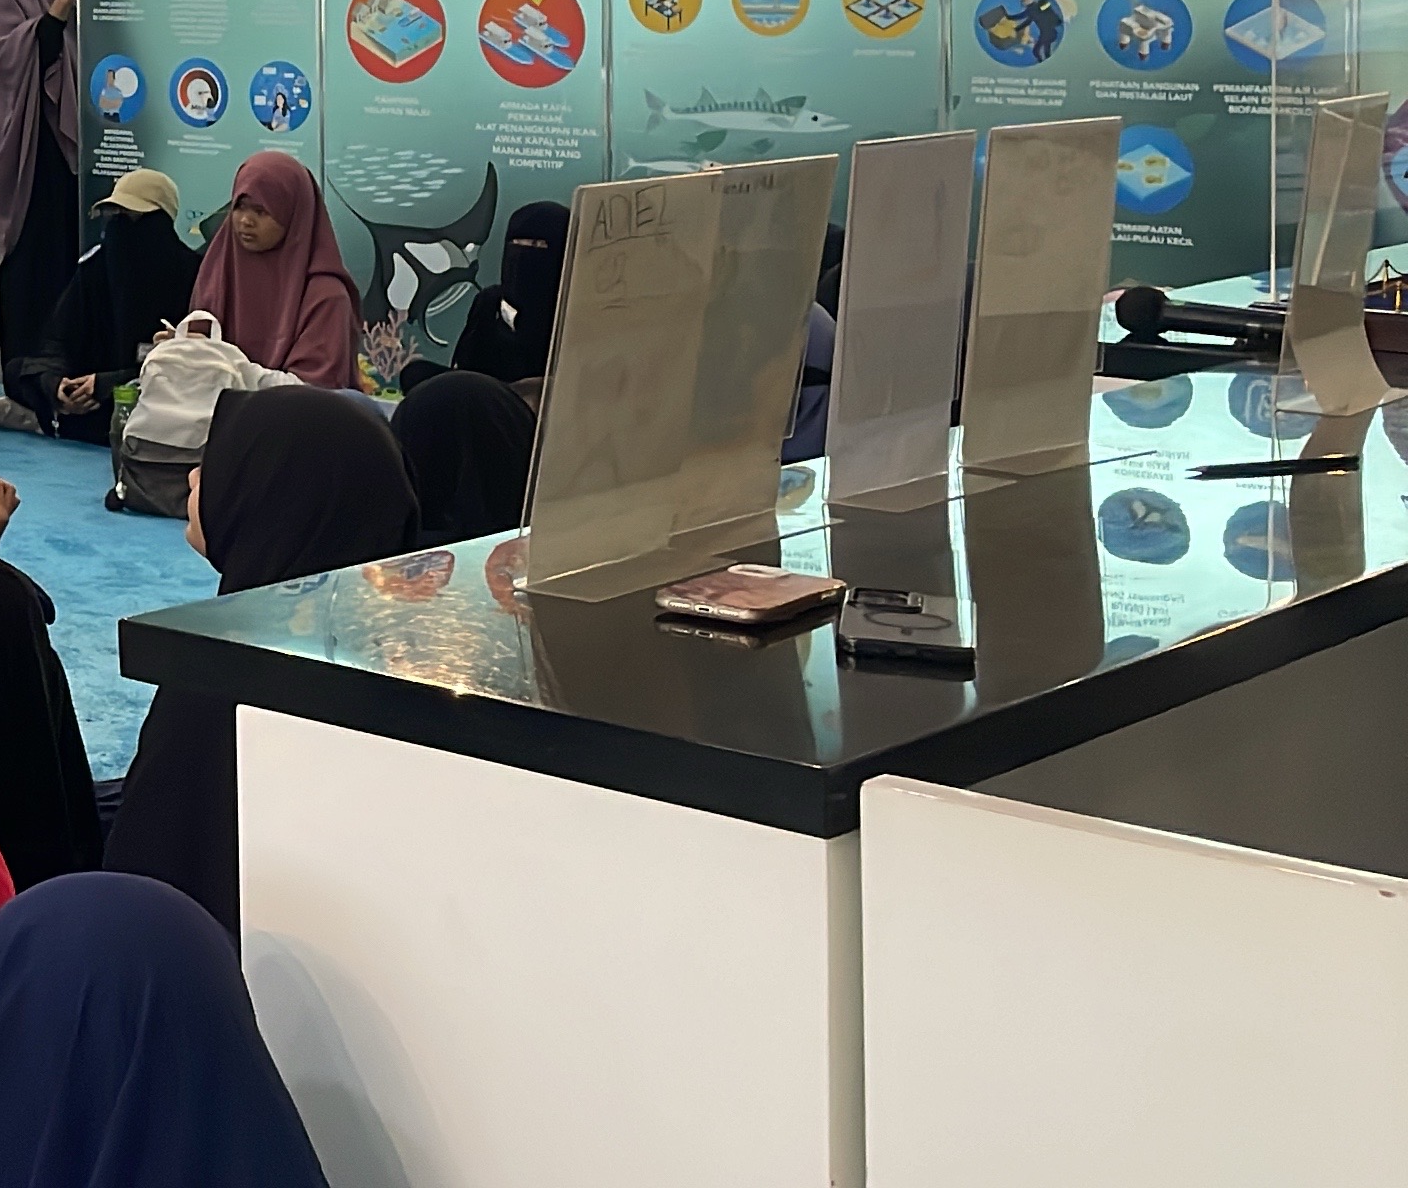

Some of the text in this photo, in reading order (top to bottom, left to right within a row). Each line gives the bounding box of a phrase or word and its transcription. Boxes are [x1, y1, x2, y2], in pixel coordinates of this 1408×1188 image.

[525, 136, 555, 146] KAPAL
[557, 138, 578, 147] DAN
[492, 145, 581, 159] MANAJEMEN YANG
[509, 158, 564, 169] KOMPETITIF
